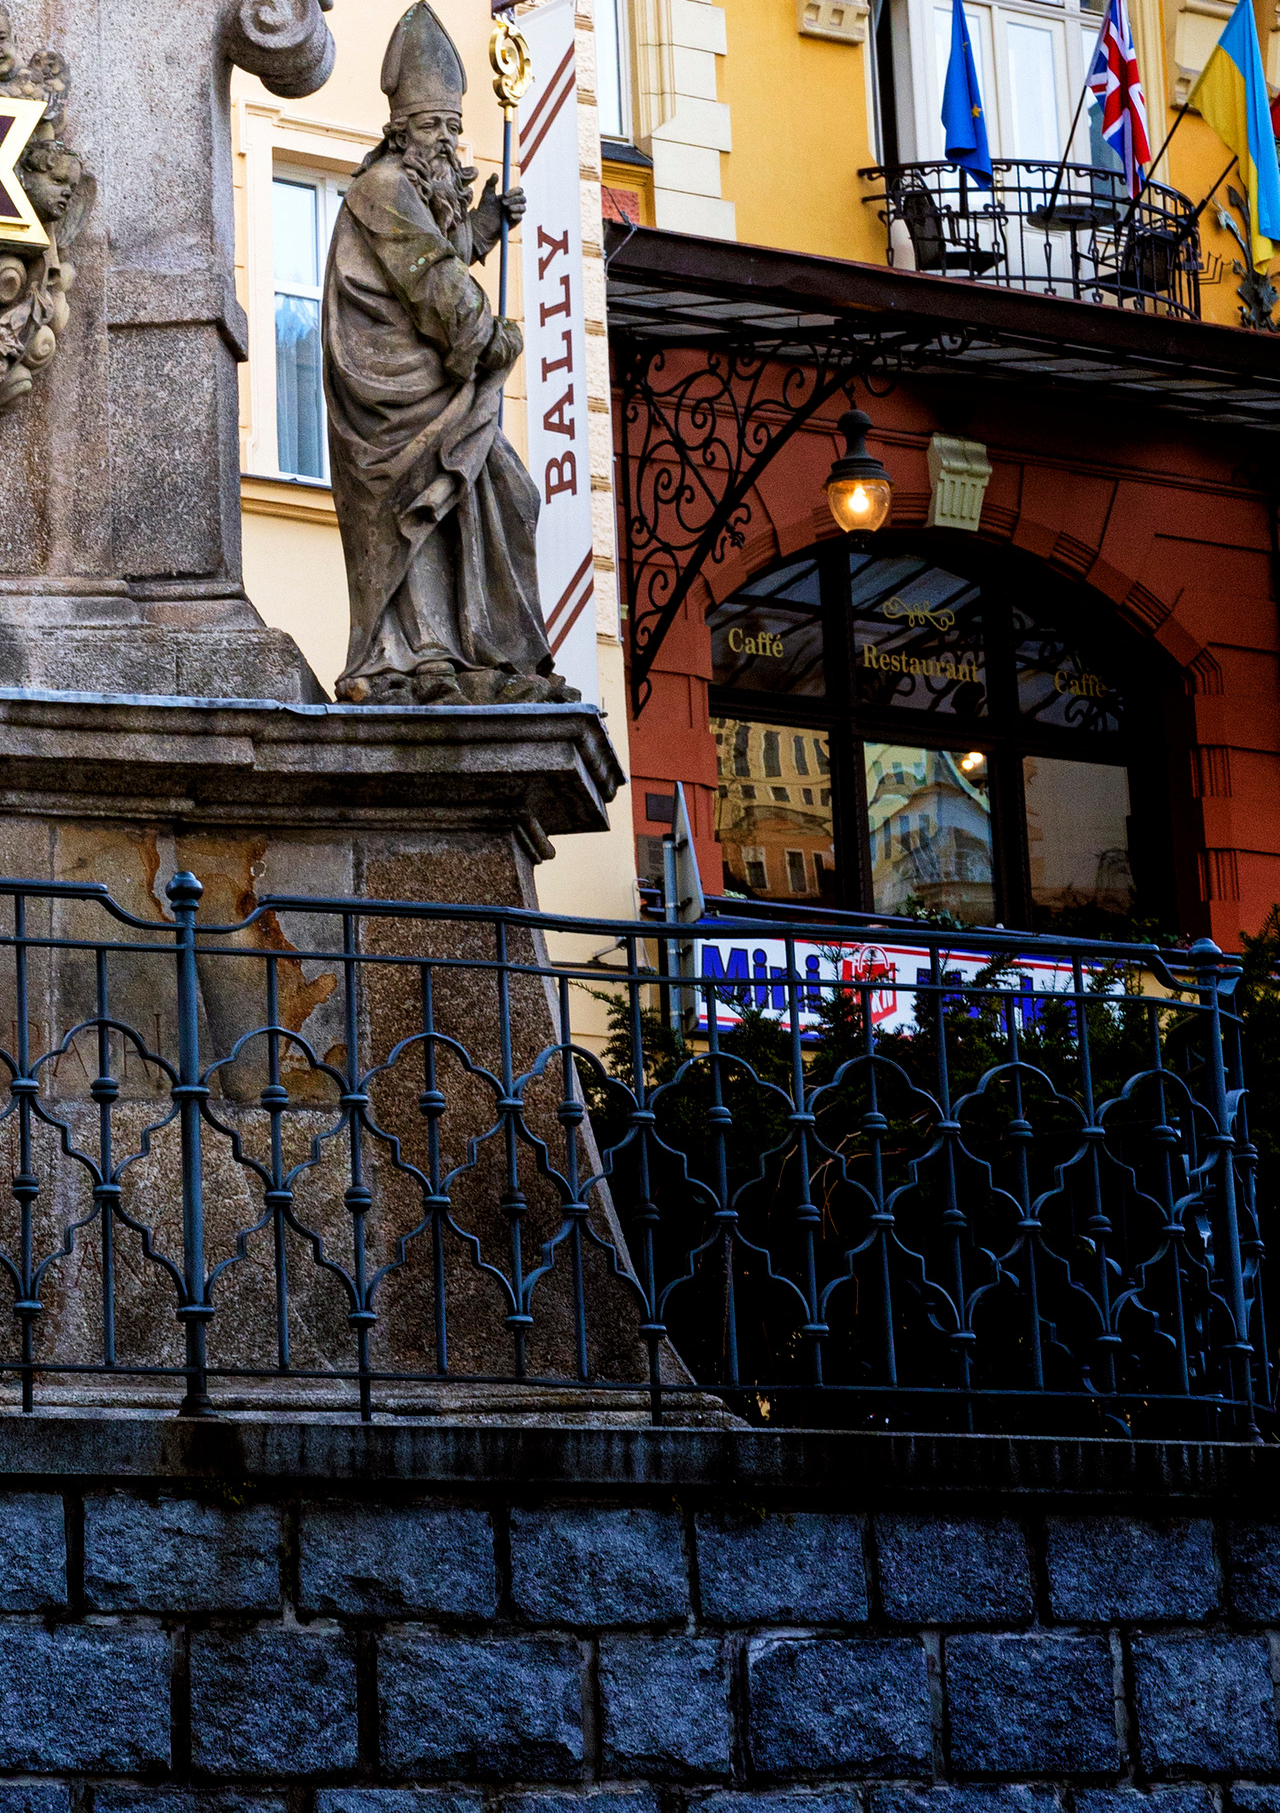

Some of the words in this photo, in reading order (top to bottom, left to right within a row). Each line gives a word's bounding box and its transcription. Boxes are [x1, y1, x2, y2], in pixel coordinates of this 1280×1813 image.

[537, 225, 577, 504] BALLY
[727, 627, 784, 658] Caffé
[862, 642, 980, 684] Restaurant
[701, 944, 820, 1014] Mini
